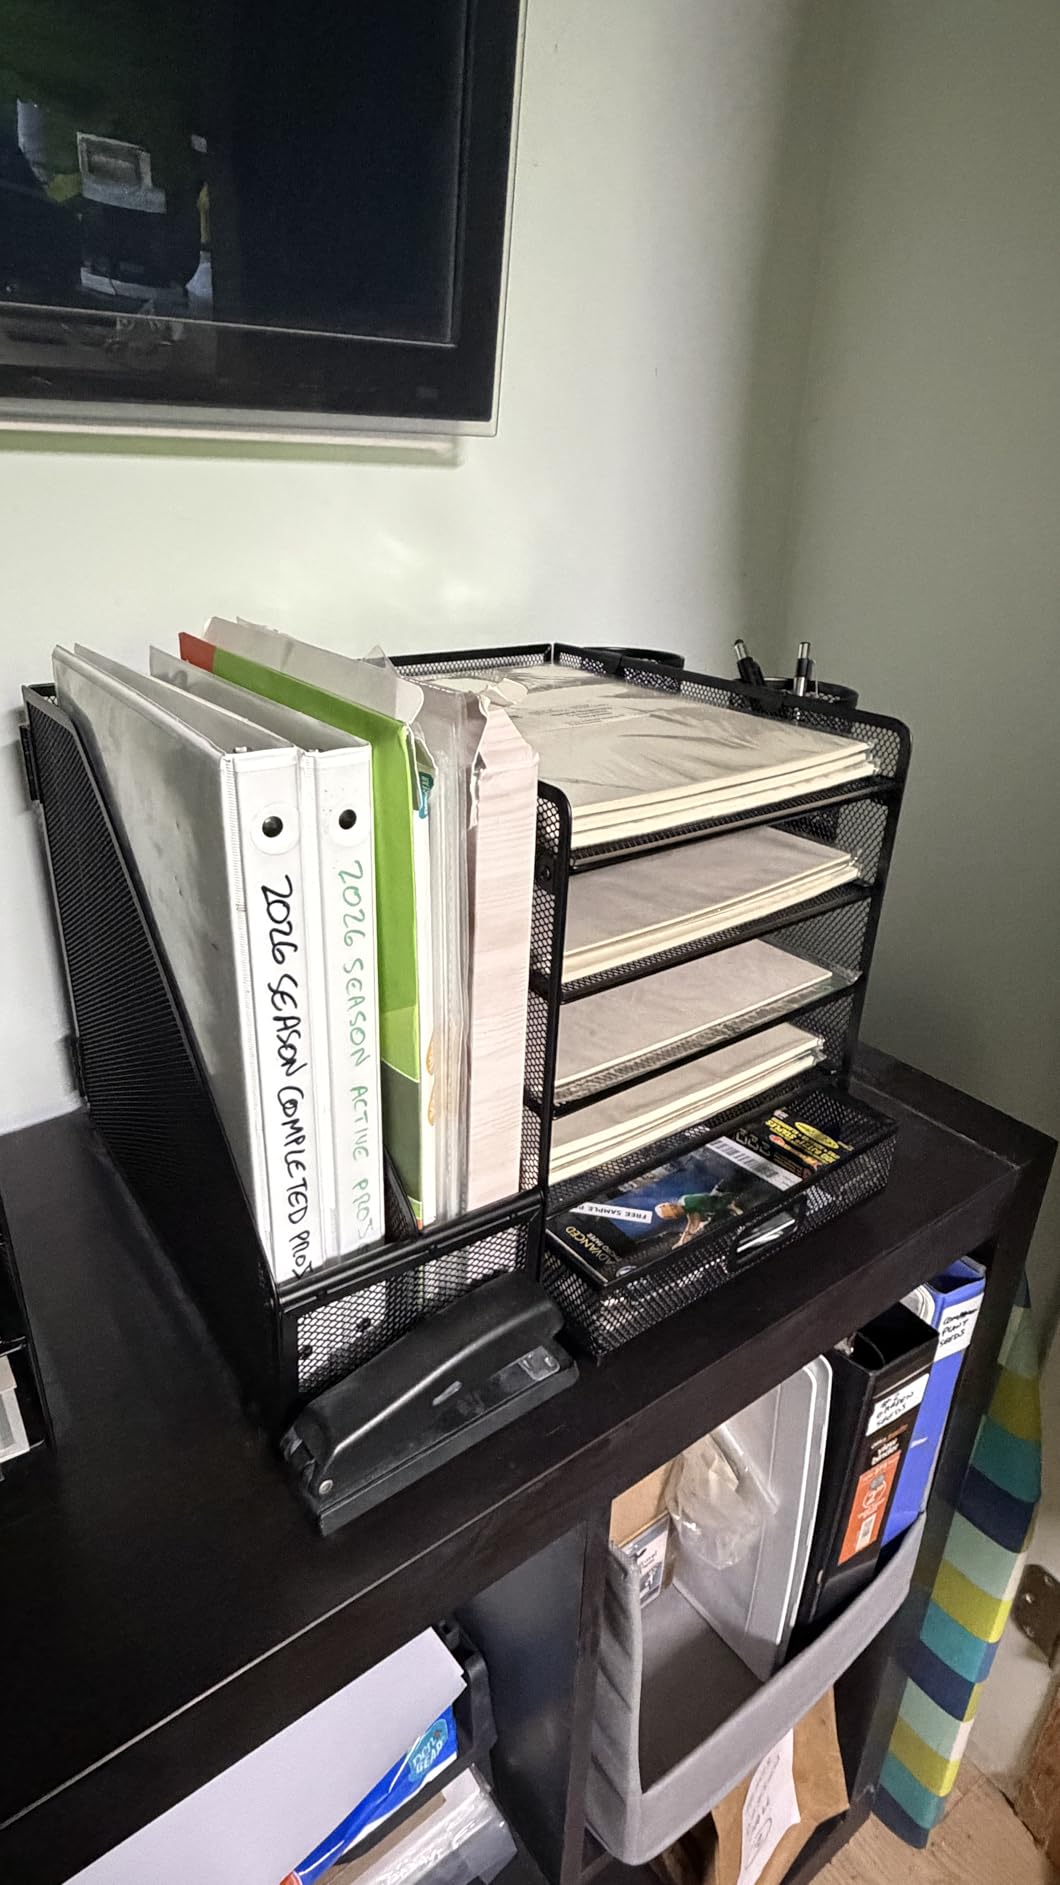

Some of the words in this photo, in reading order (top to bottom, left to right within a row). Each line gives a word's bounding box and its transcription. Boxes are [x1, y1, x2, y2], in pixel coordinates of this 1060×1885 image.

[261, 874, 298, 965] 2026
[338, 858, 366, 947] 2026
[267, 973, 308, 1077] SEASON
[343, 958, 371, 1067] SEASON
[277, 1085, 309, 1225] COMPLETED
[350, 1085, 369, 1161] ACTIVE
[565, 1226, 615, 1265] ADVANCED
[586, 1232, 604, 1246] PAPER
[589, 1206, 622, 1216] SAMPLE
[602, 1245, 622, 1262] PHOTO
